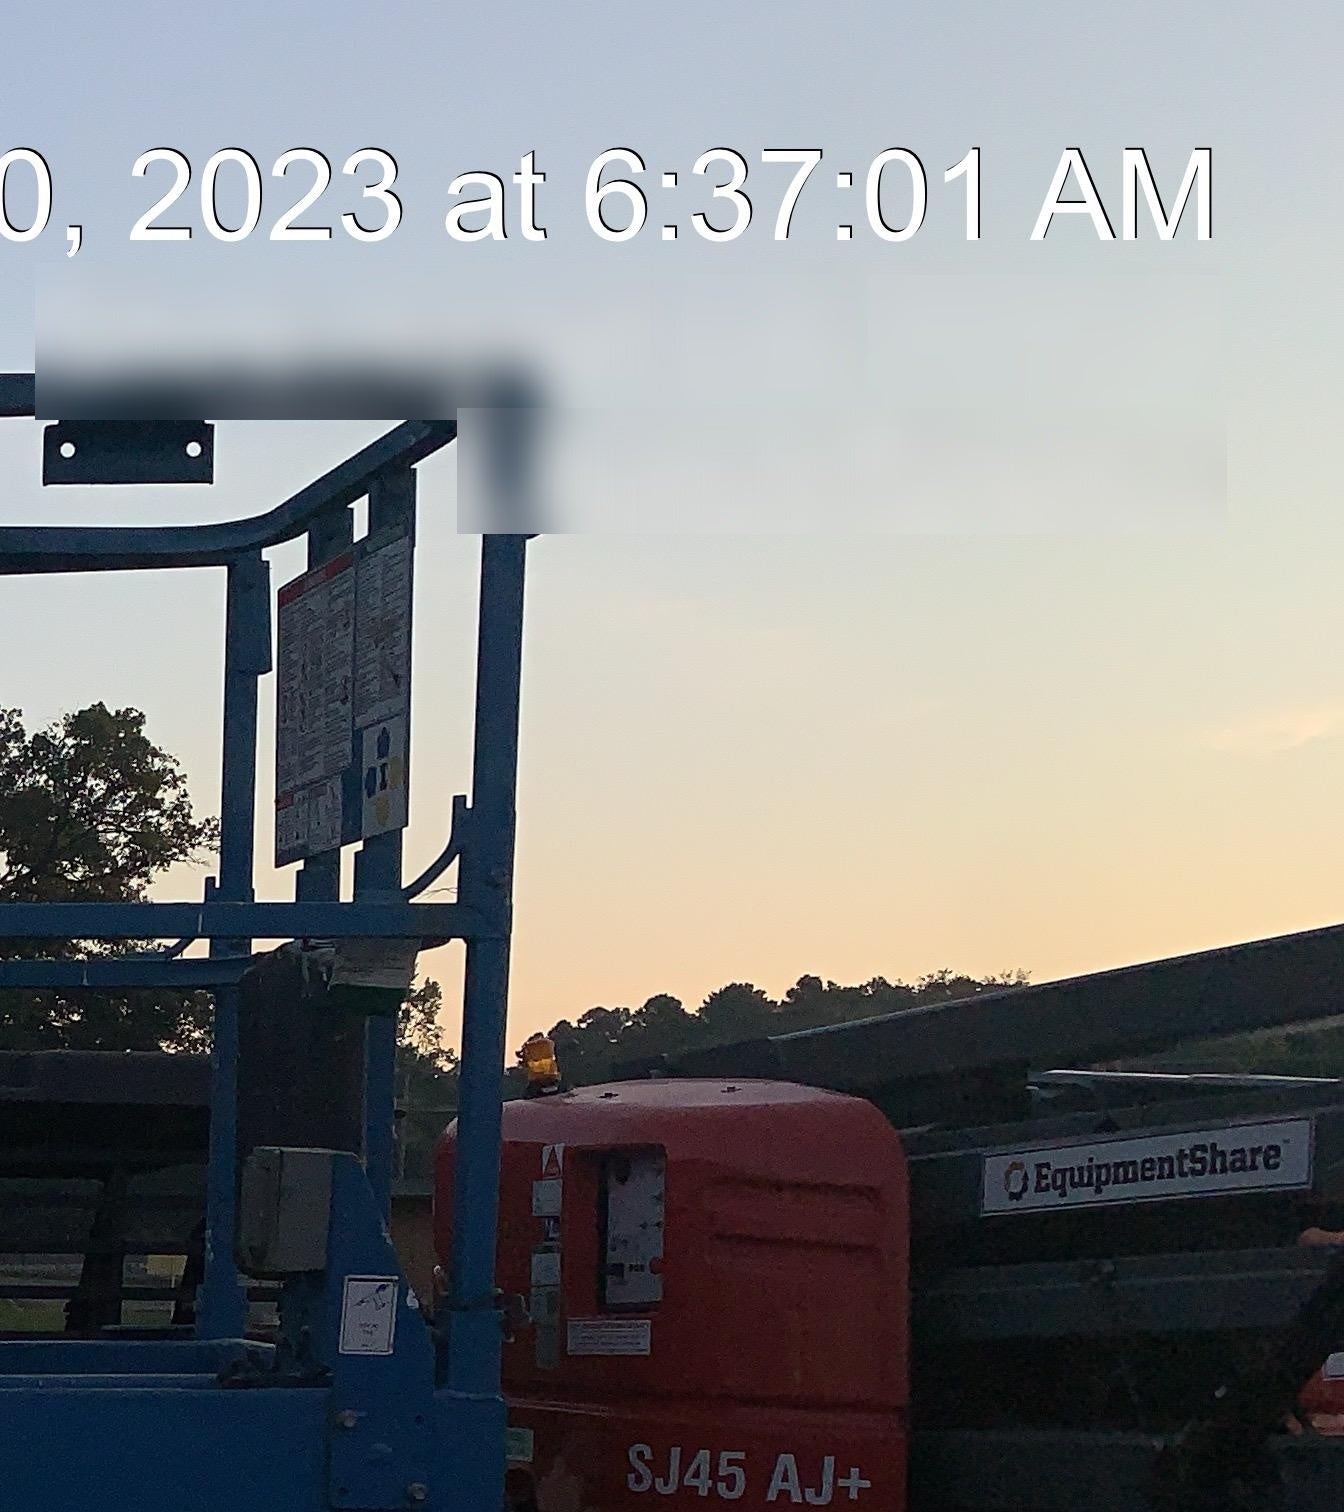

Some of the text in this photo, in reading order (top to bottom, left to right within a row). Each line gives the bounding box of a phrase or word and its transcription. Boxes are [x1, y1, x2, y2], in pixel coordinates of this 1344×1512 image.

[1033, 1141, 1282, 1199] EquipmentShare
[625, 1442, 873, 1507] SJ45 AJ+
